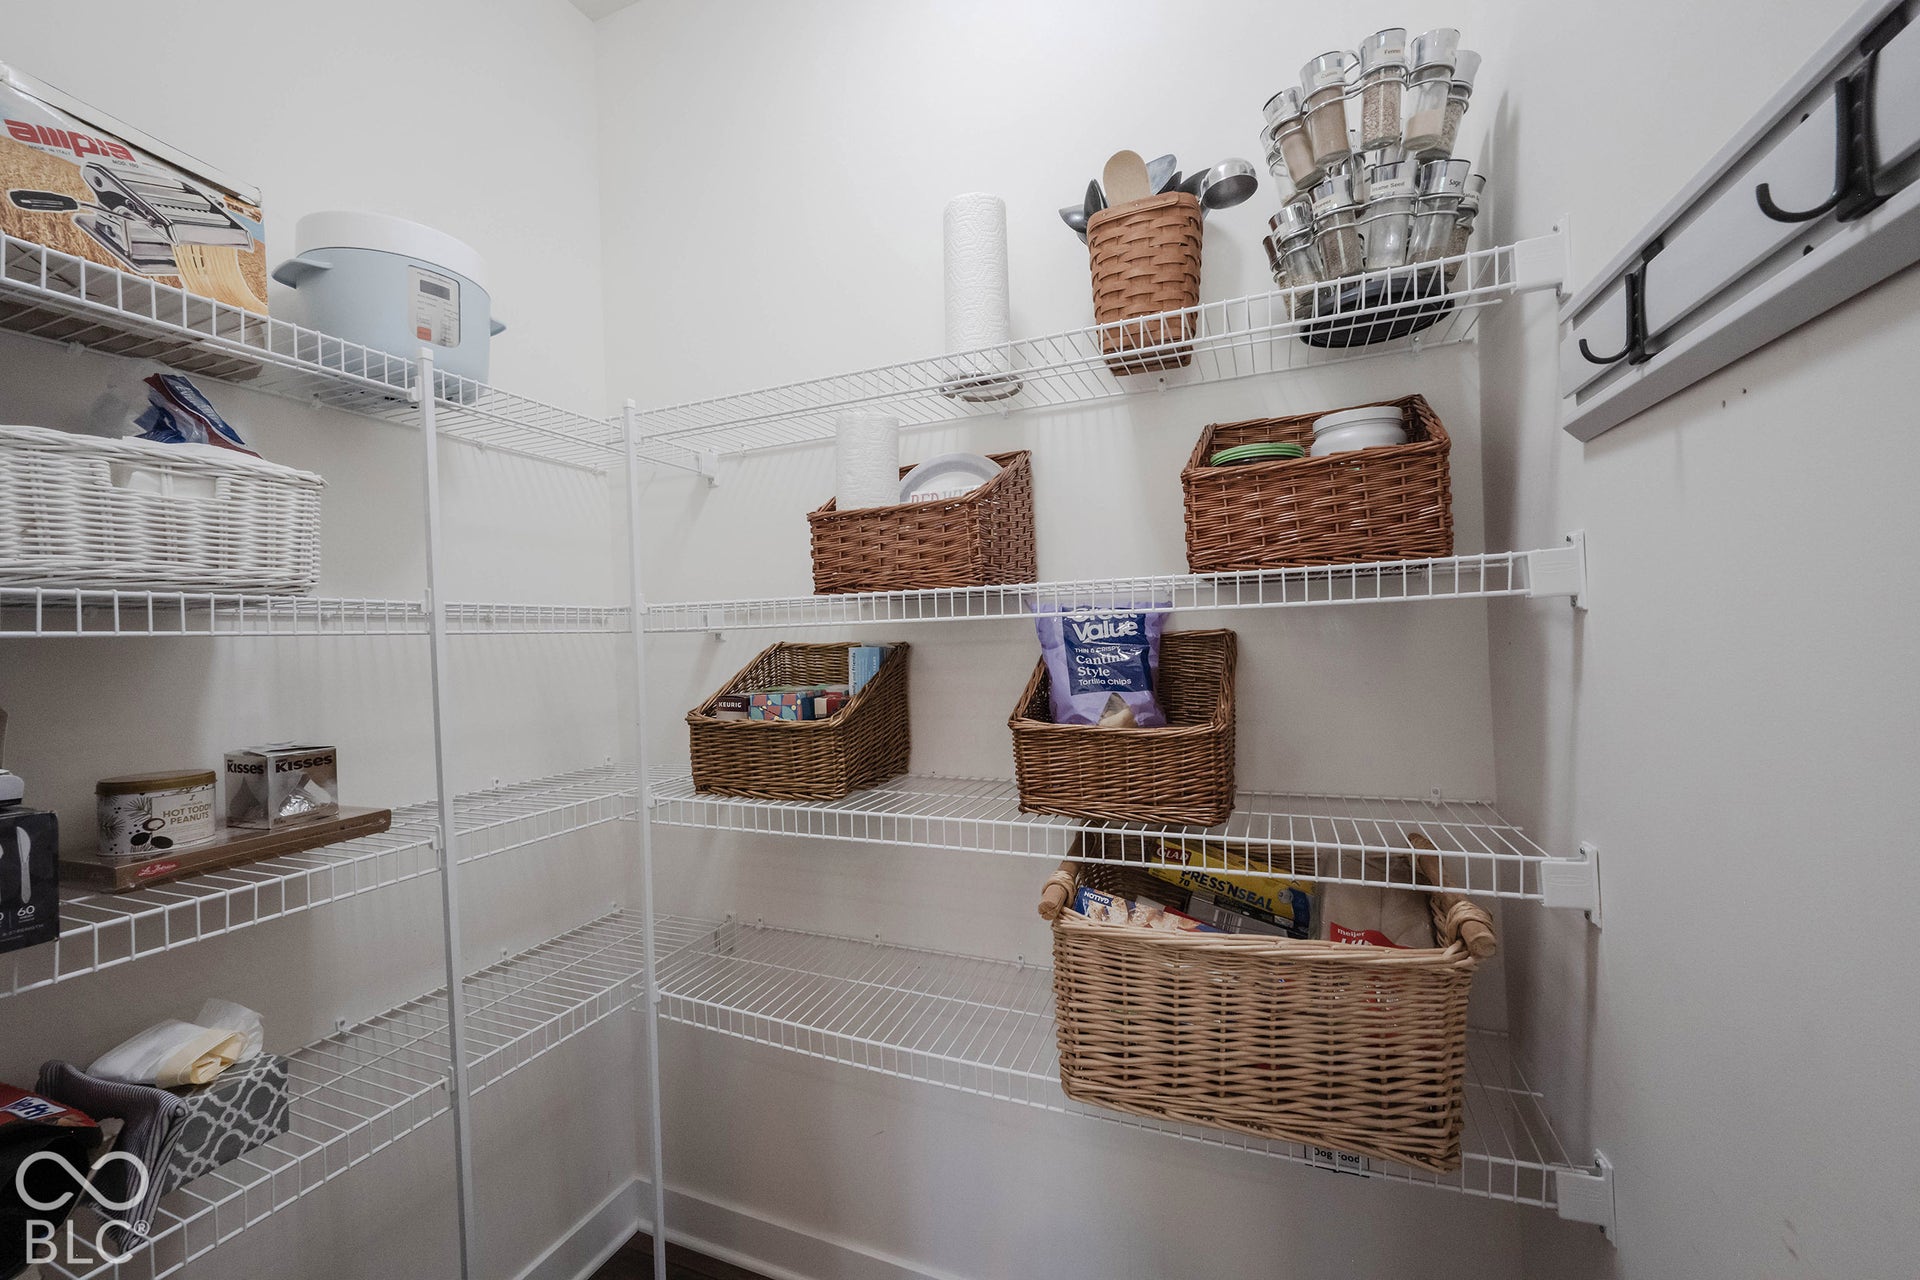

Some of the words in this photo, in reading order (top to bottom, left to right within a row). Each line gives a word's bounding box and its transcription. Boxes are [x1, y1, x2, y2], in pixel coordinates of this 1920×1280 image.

[1072, 620, 1139, 641] Value
[1077, 666, 1111, 678] Style
[1078, 678, 1106, 686] Tortilla
[1107, 678, 1132, 686] Chips
[718, 700, 742, 709] KEURIG
[162, 808, 185, 819] HOT
[170, 811, 209, 825] PEANUTS
[1156, 847, 1190, 861] GLAD
[17, 905, 36, 917] 60
[1337, 928, 1366, 938] meijer
[1314, 1147, 1333, 1160] Dog
[1337, 1151, 1360, 1164] ood
